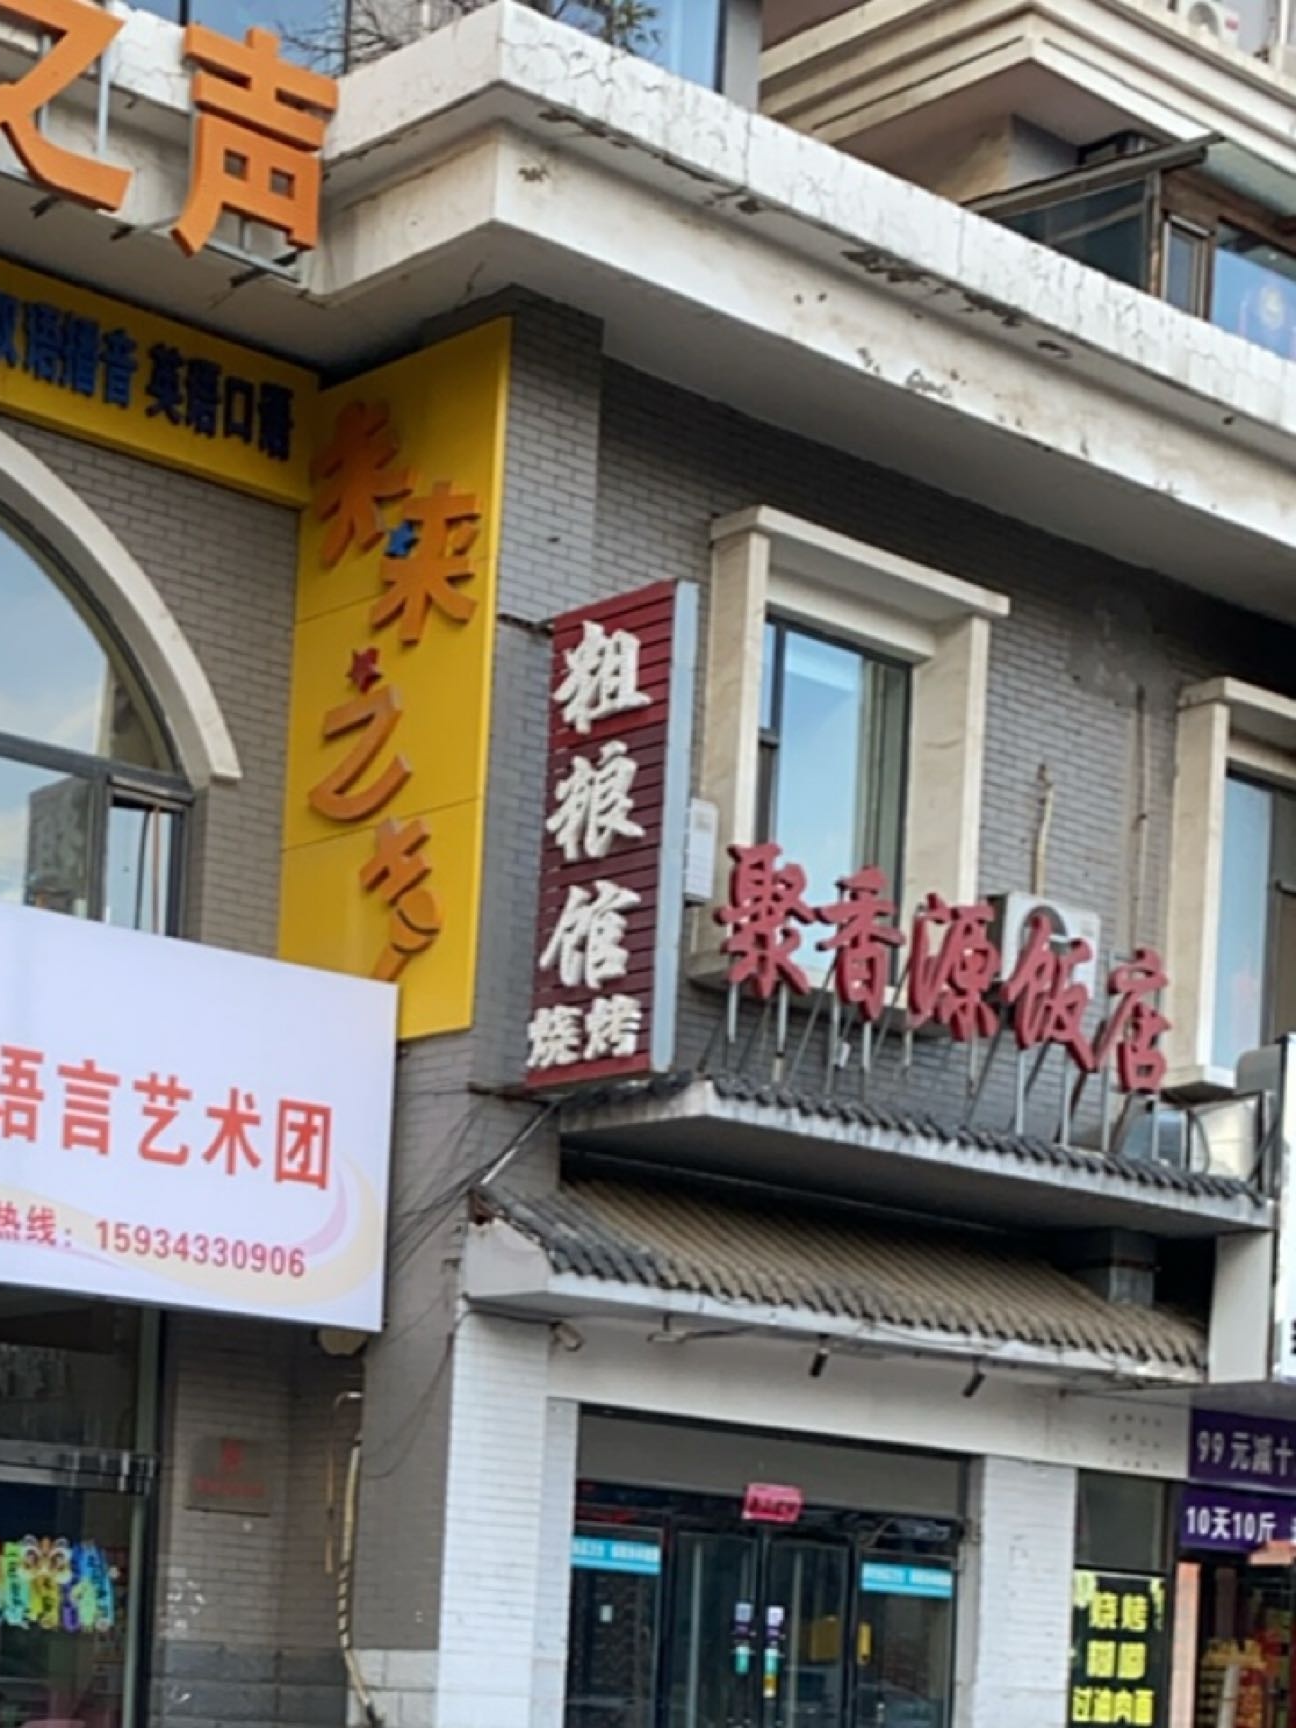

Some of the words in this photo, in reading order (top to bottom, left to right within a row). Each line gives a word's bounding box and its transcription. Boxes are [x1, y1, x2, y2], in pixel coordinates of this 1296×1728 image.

[539, 621, 652, 990] 粗粮馆
[526, 996, 643, 1068] 烧烤
[714, 842, 1172, 1095] 聚香源饭店
[1186, 1505, 1278, 1543] 10天10斤
